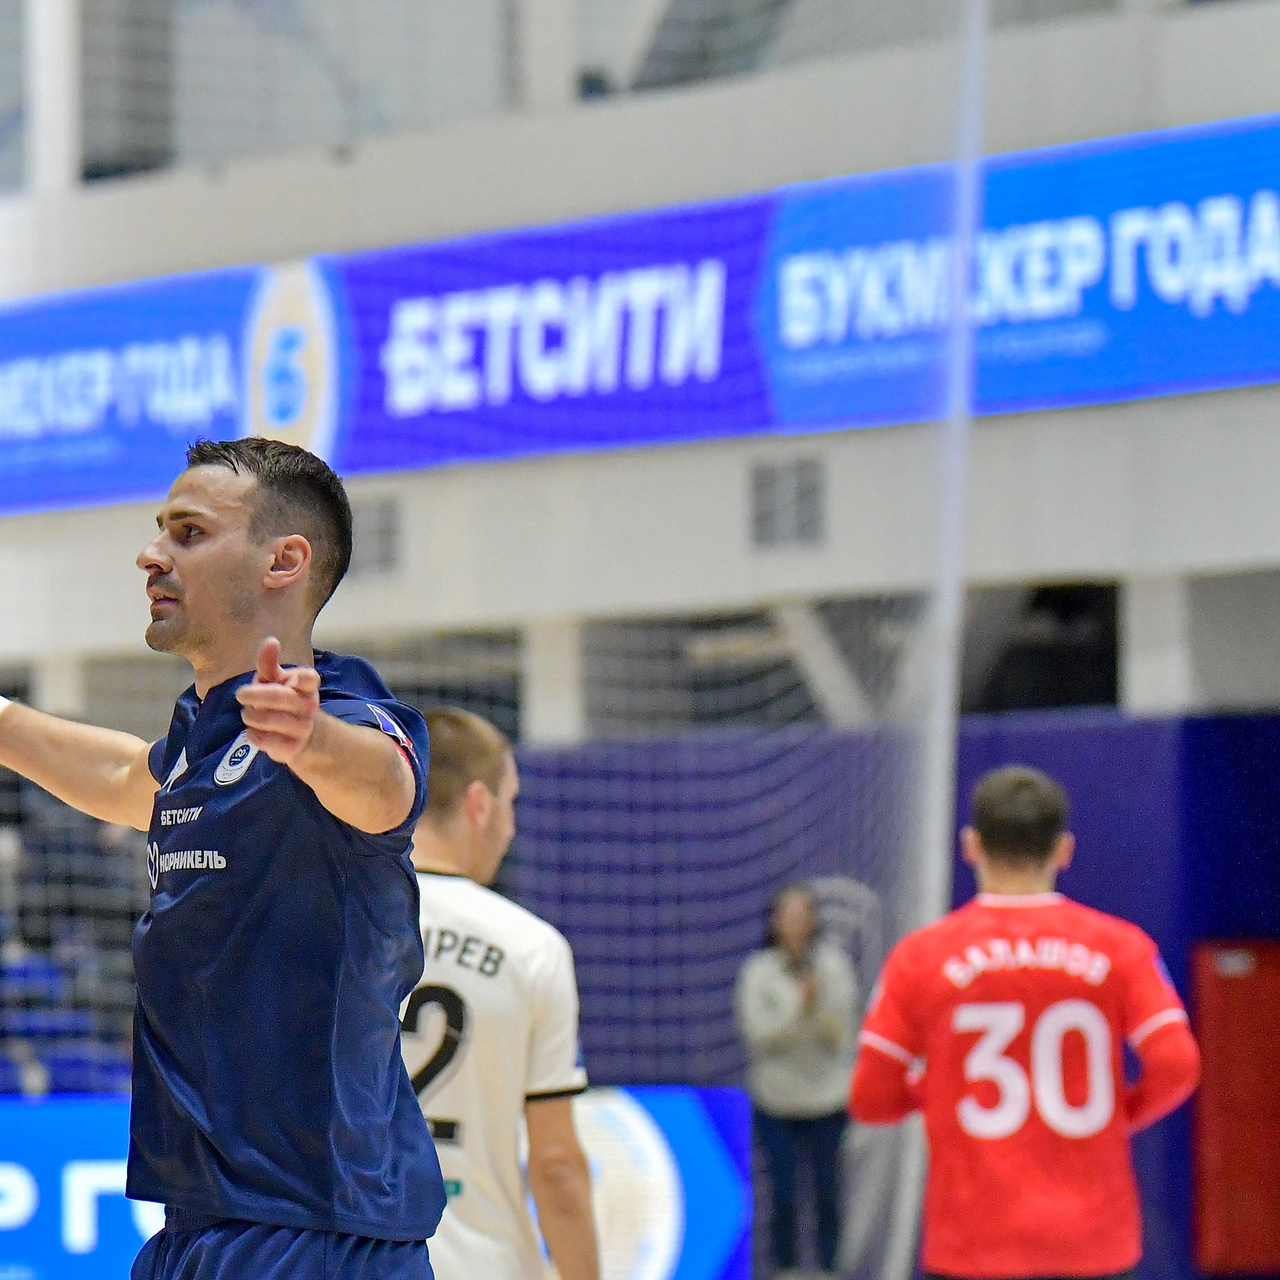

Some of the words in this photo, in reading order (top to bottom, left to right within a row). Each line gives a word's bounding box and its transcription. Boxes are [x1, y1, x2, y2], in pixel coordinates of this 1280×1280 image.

[1109, 187, 1280, 317] ГОДА
[383, 257, 727, 419] БЕТСИТИ
[160, 850, 227, 873] НОРНИКЕЛЬ
[161, 806, 203, 826] БЕТСИТИ
[951, 998, 1116, 1140] 30
